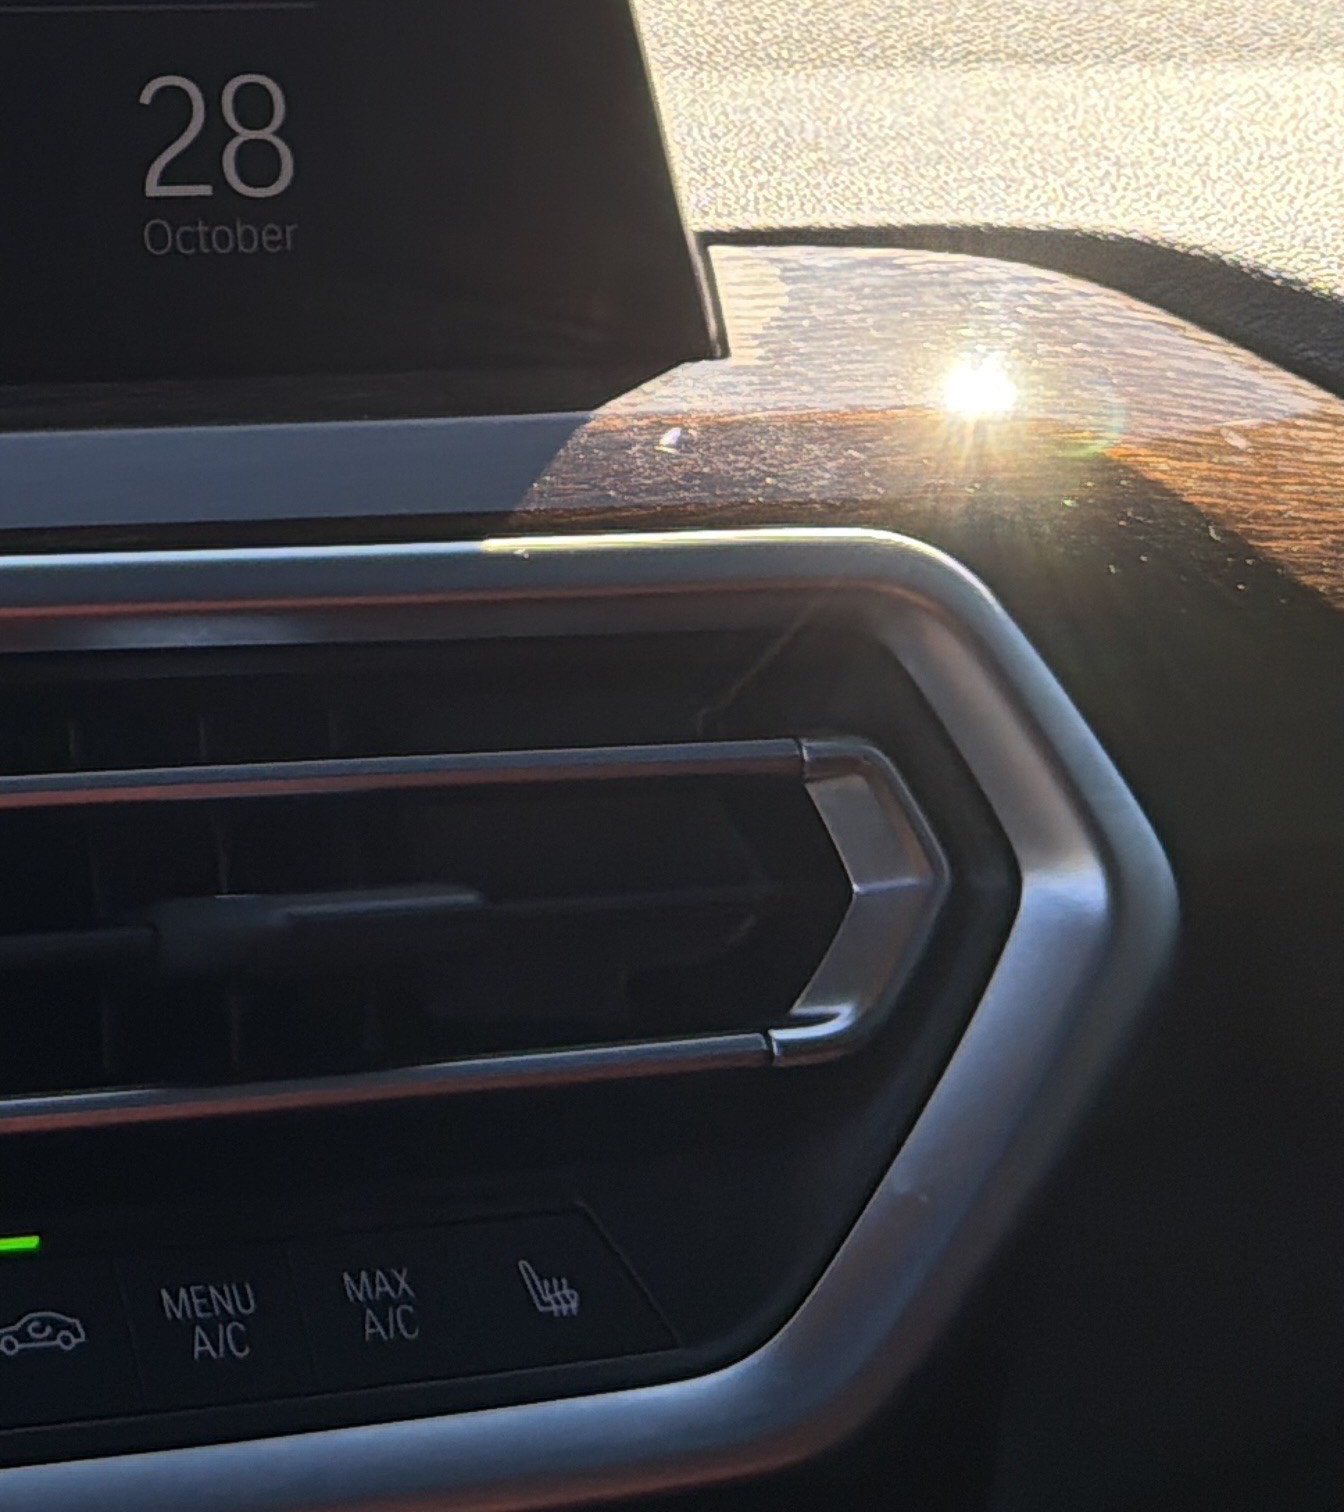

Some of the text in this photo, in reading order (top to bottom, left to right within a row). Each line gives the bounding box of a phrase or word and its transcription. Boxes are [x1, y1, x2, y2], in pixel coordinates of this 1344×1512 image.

[140, 74, 293, 197] 28
[144, 219, 298, 255] October
[161, 1283, 255, 1321] MENU
[343, 1269, 414, 1301] MAX
[194, 1322, 249, 1359] A/C
[365, 1305, 419, 1340] A/C
